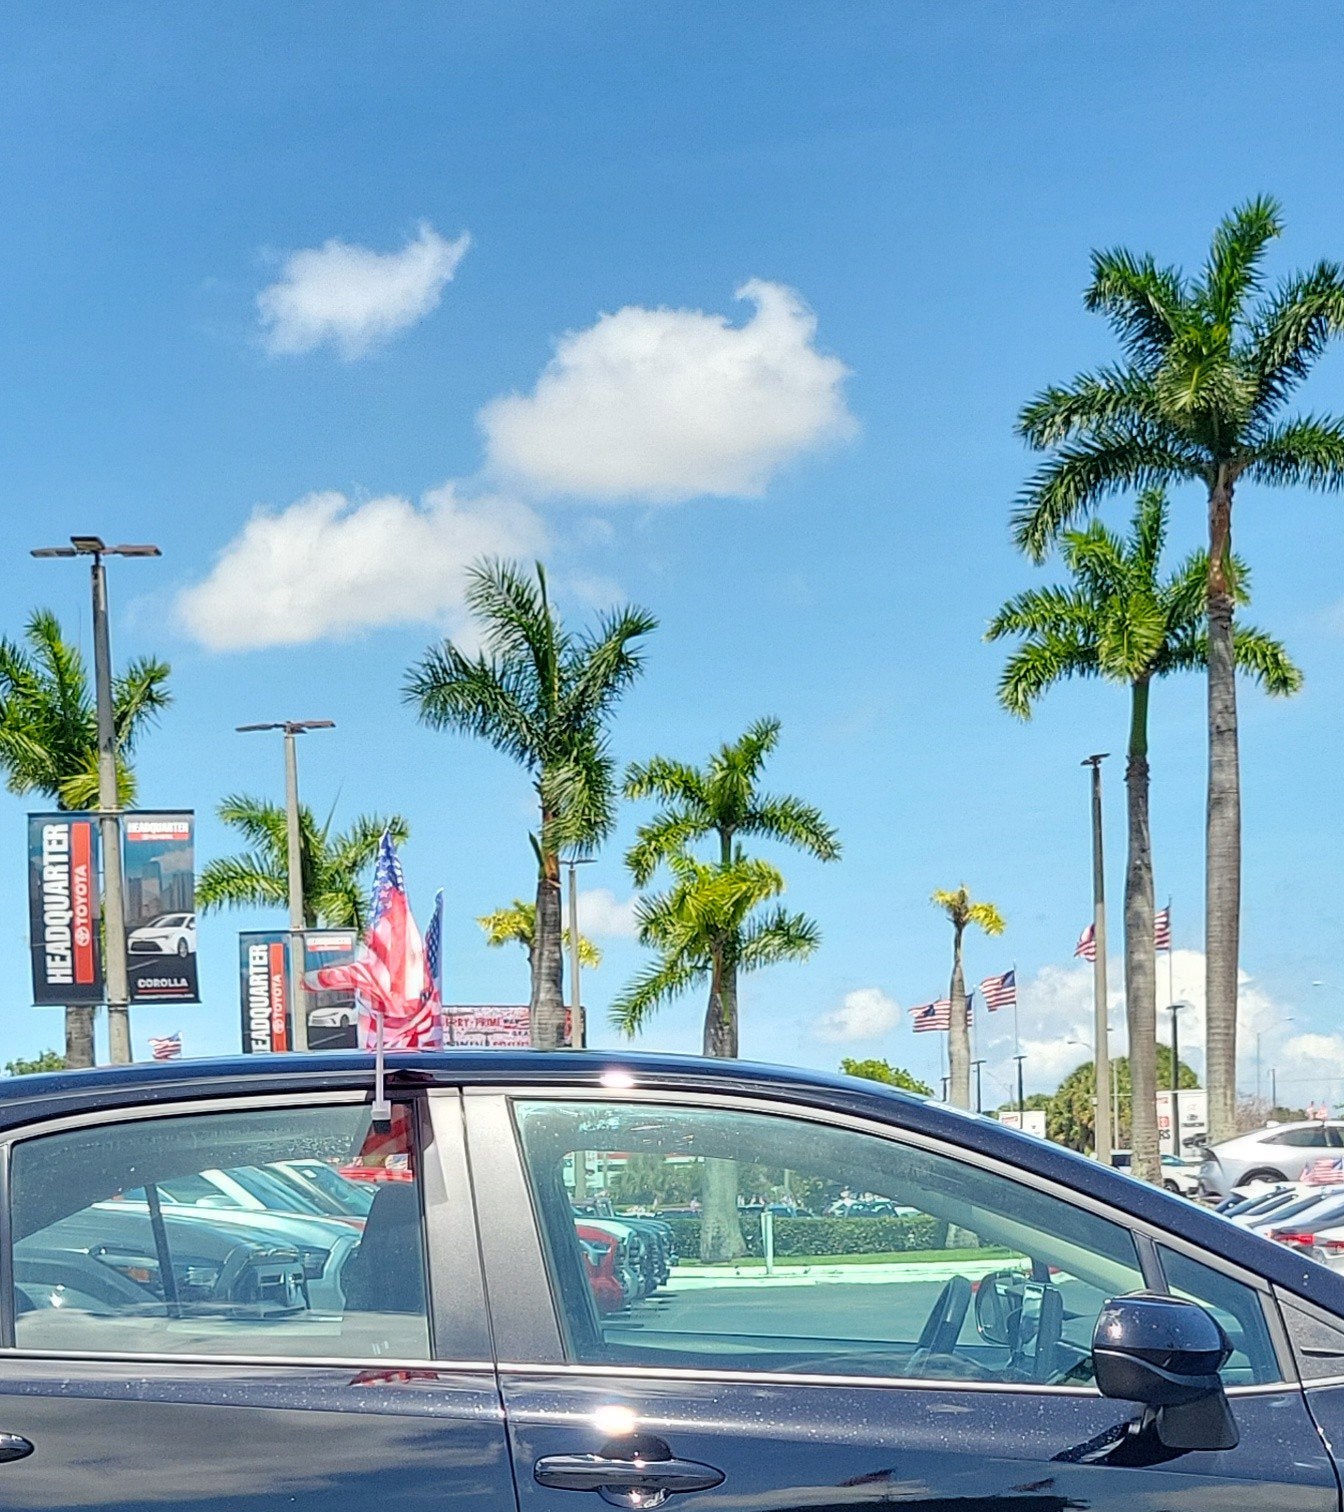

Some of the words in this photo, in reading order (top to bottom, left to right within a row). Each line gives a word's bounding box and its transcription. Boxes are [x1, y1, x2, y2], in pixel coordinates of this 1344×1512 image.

[42, 823, 74, 984] HEADQUARTER
[75, 864, 88, 925] TOYOTA
[138, 978, 188, 988] COROLLA
[272, 974, 283, 1019] TOYOTA
